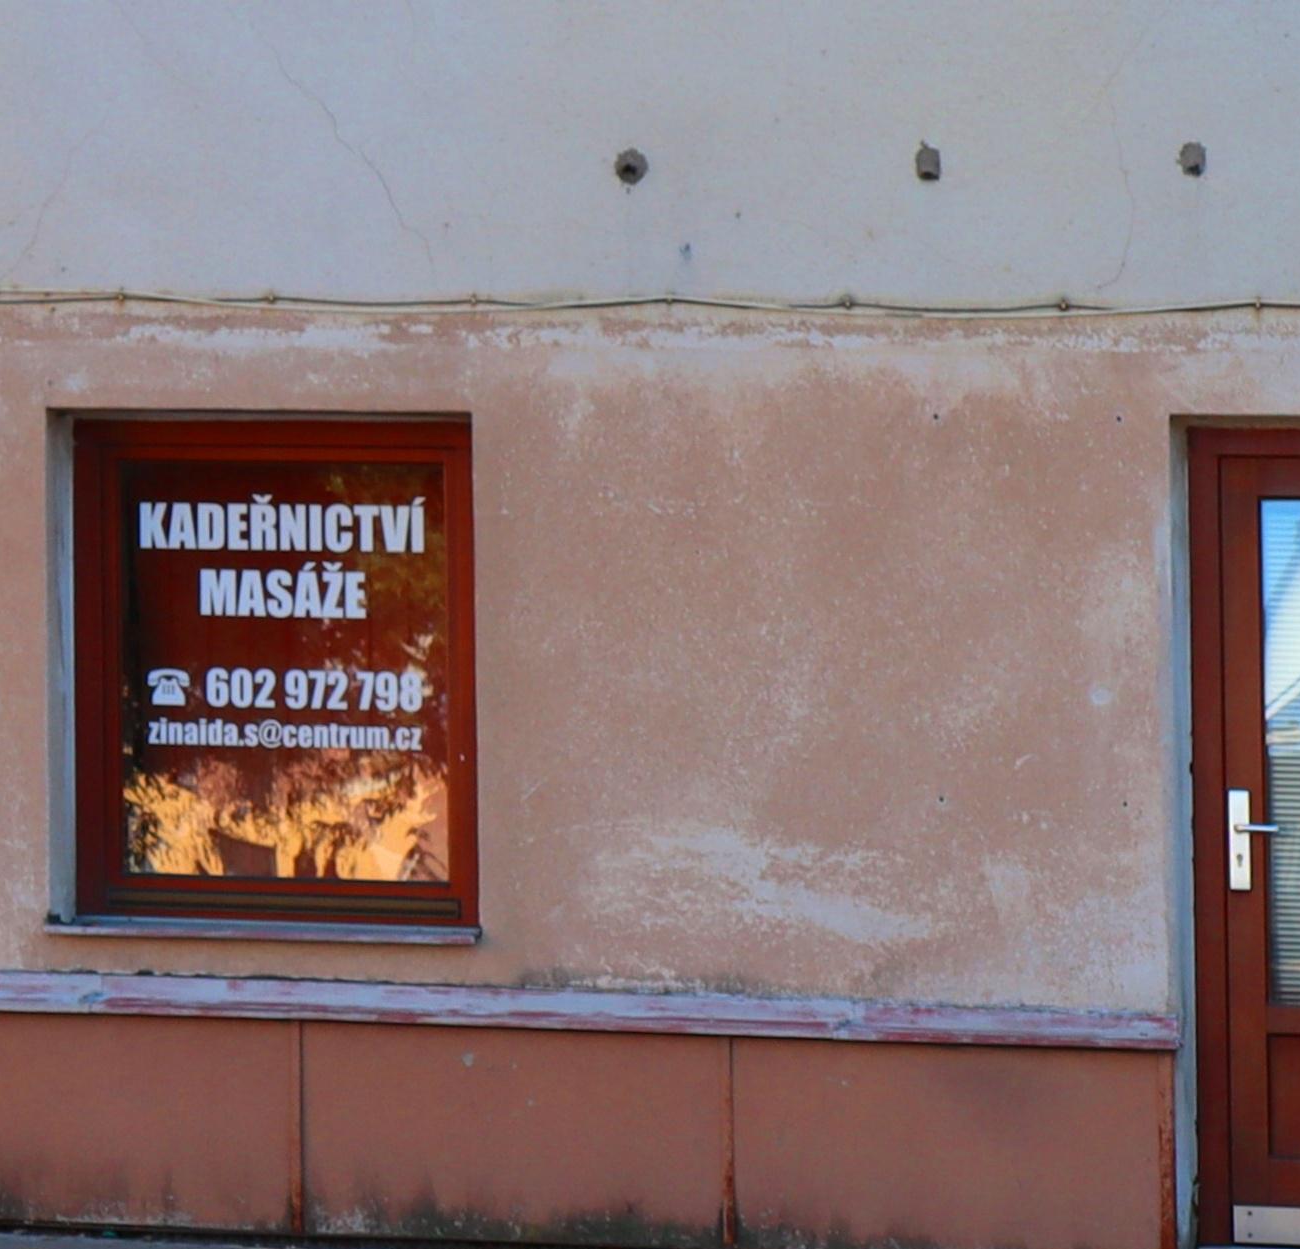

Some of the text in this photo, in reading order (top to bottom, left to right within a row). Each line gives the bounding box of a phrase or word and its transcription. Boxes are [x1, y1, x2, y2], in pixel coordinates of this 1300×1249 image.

[139, 494, 425, 553] KADEŘNICTVÍ
[200, 562, 366, 619] MASÁŽE
[206, 668, 424, 713] 602 972 798
[148, 719, 422, 751] zinaida.s@centrum.cz
